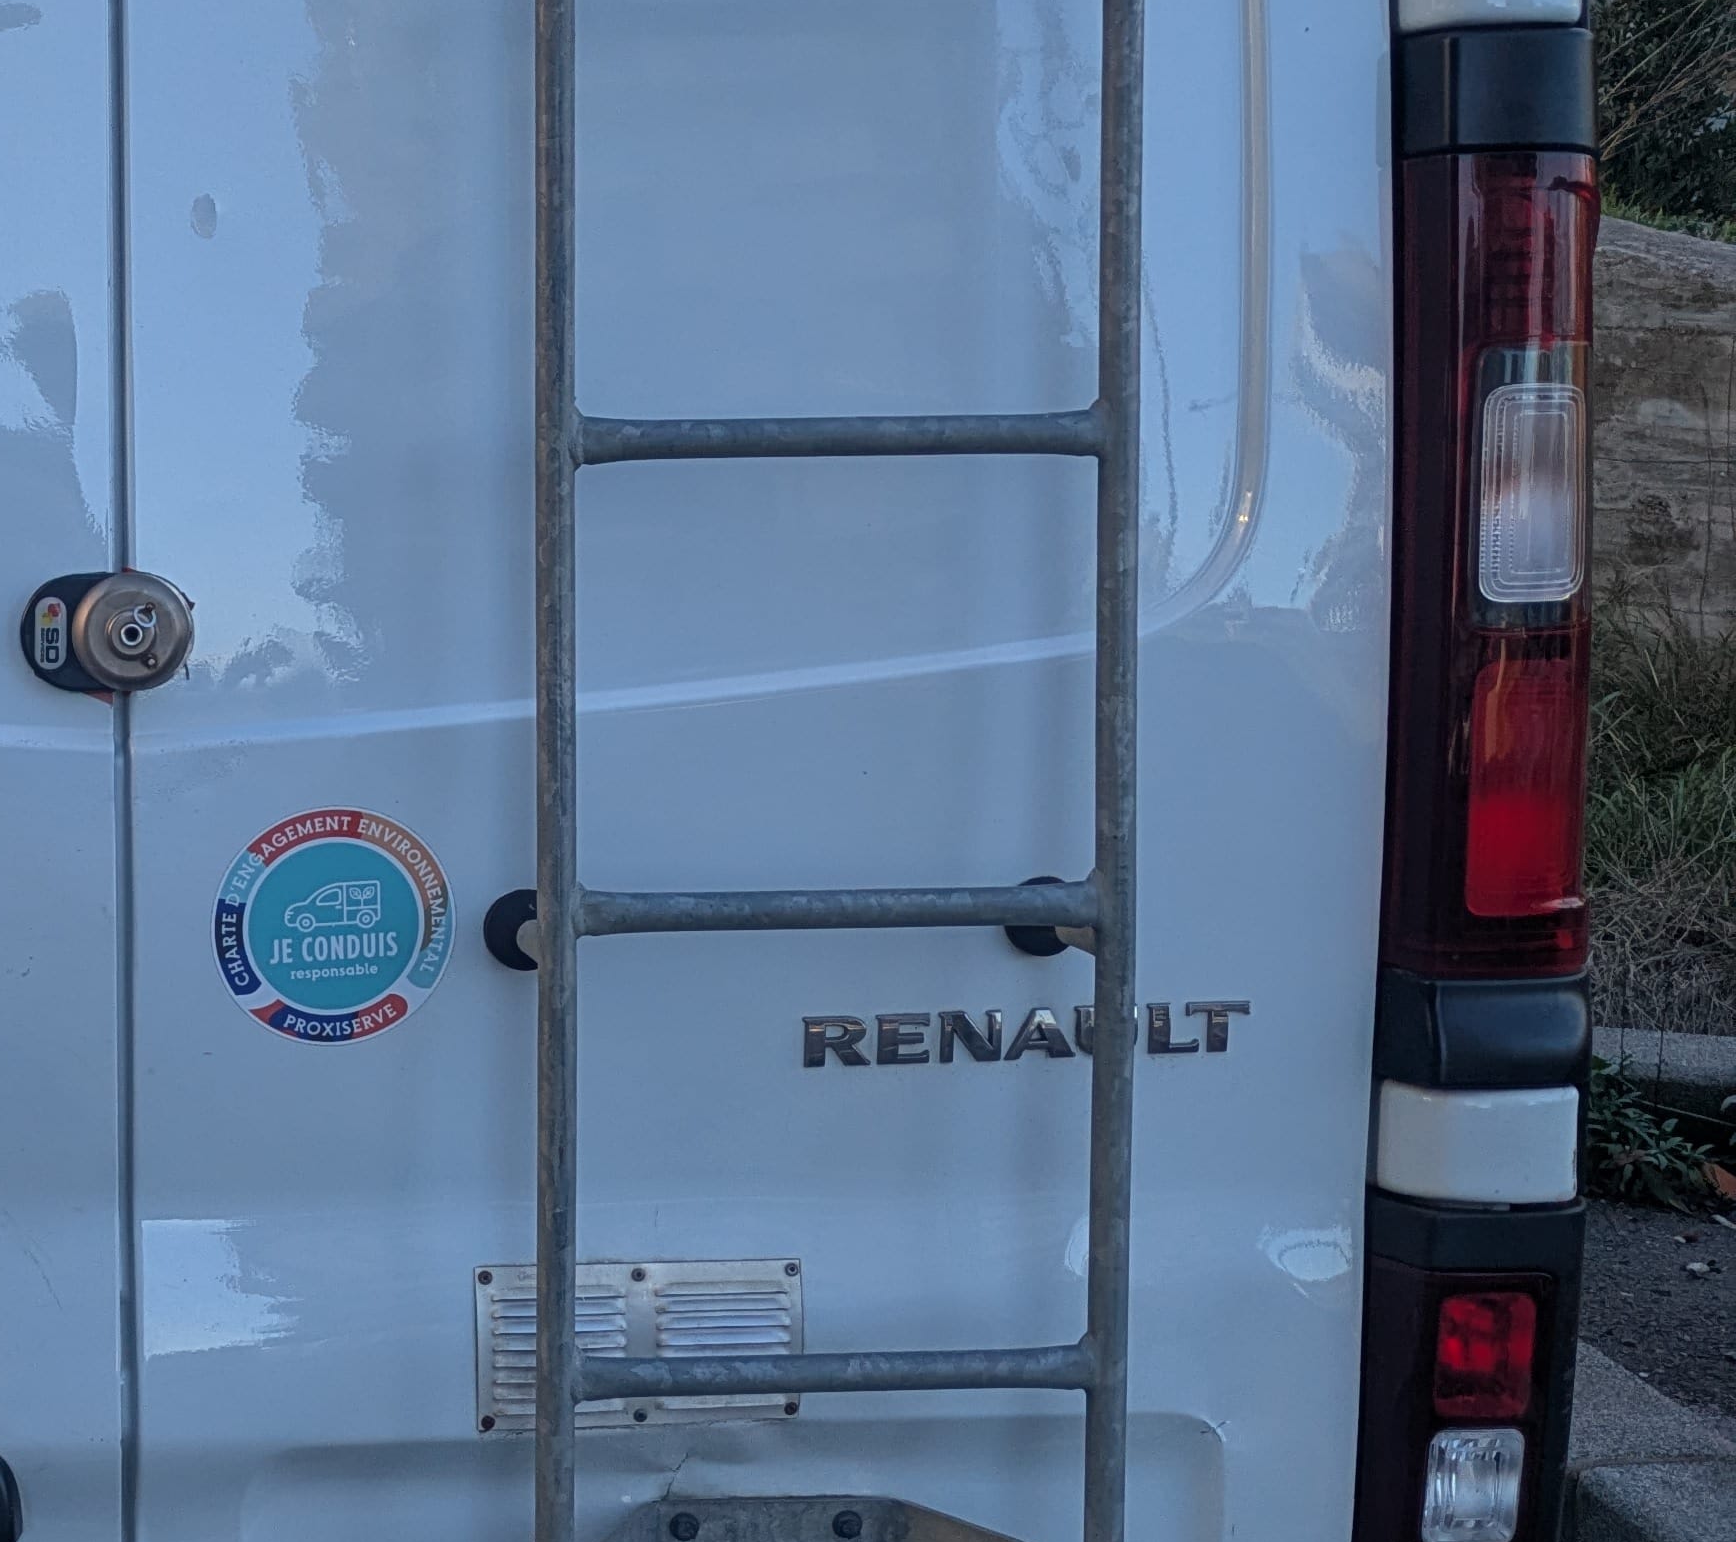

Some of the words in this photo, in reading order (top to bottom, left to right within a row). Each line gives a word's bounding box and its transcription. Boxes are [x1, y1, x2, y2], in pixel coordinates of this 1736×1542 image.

[46, 627, 60, 664] SD
[225, 815, 352, 907] D'ENGAGEMENT
[357, 819, 446, 973] ENVIRONNEMENTAL
[221, 912, 250, 987] CHARTE
[269, 939, 293, 965] JE
[301, 931, 399, 961] CONDUIS
[290, 962, 379, 981] responsable
[283, 1003, 397, 1037] PROXISERVE
